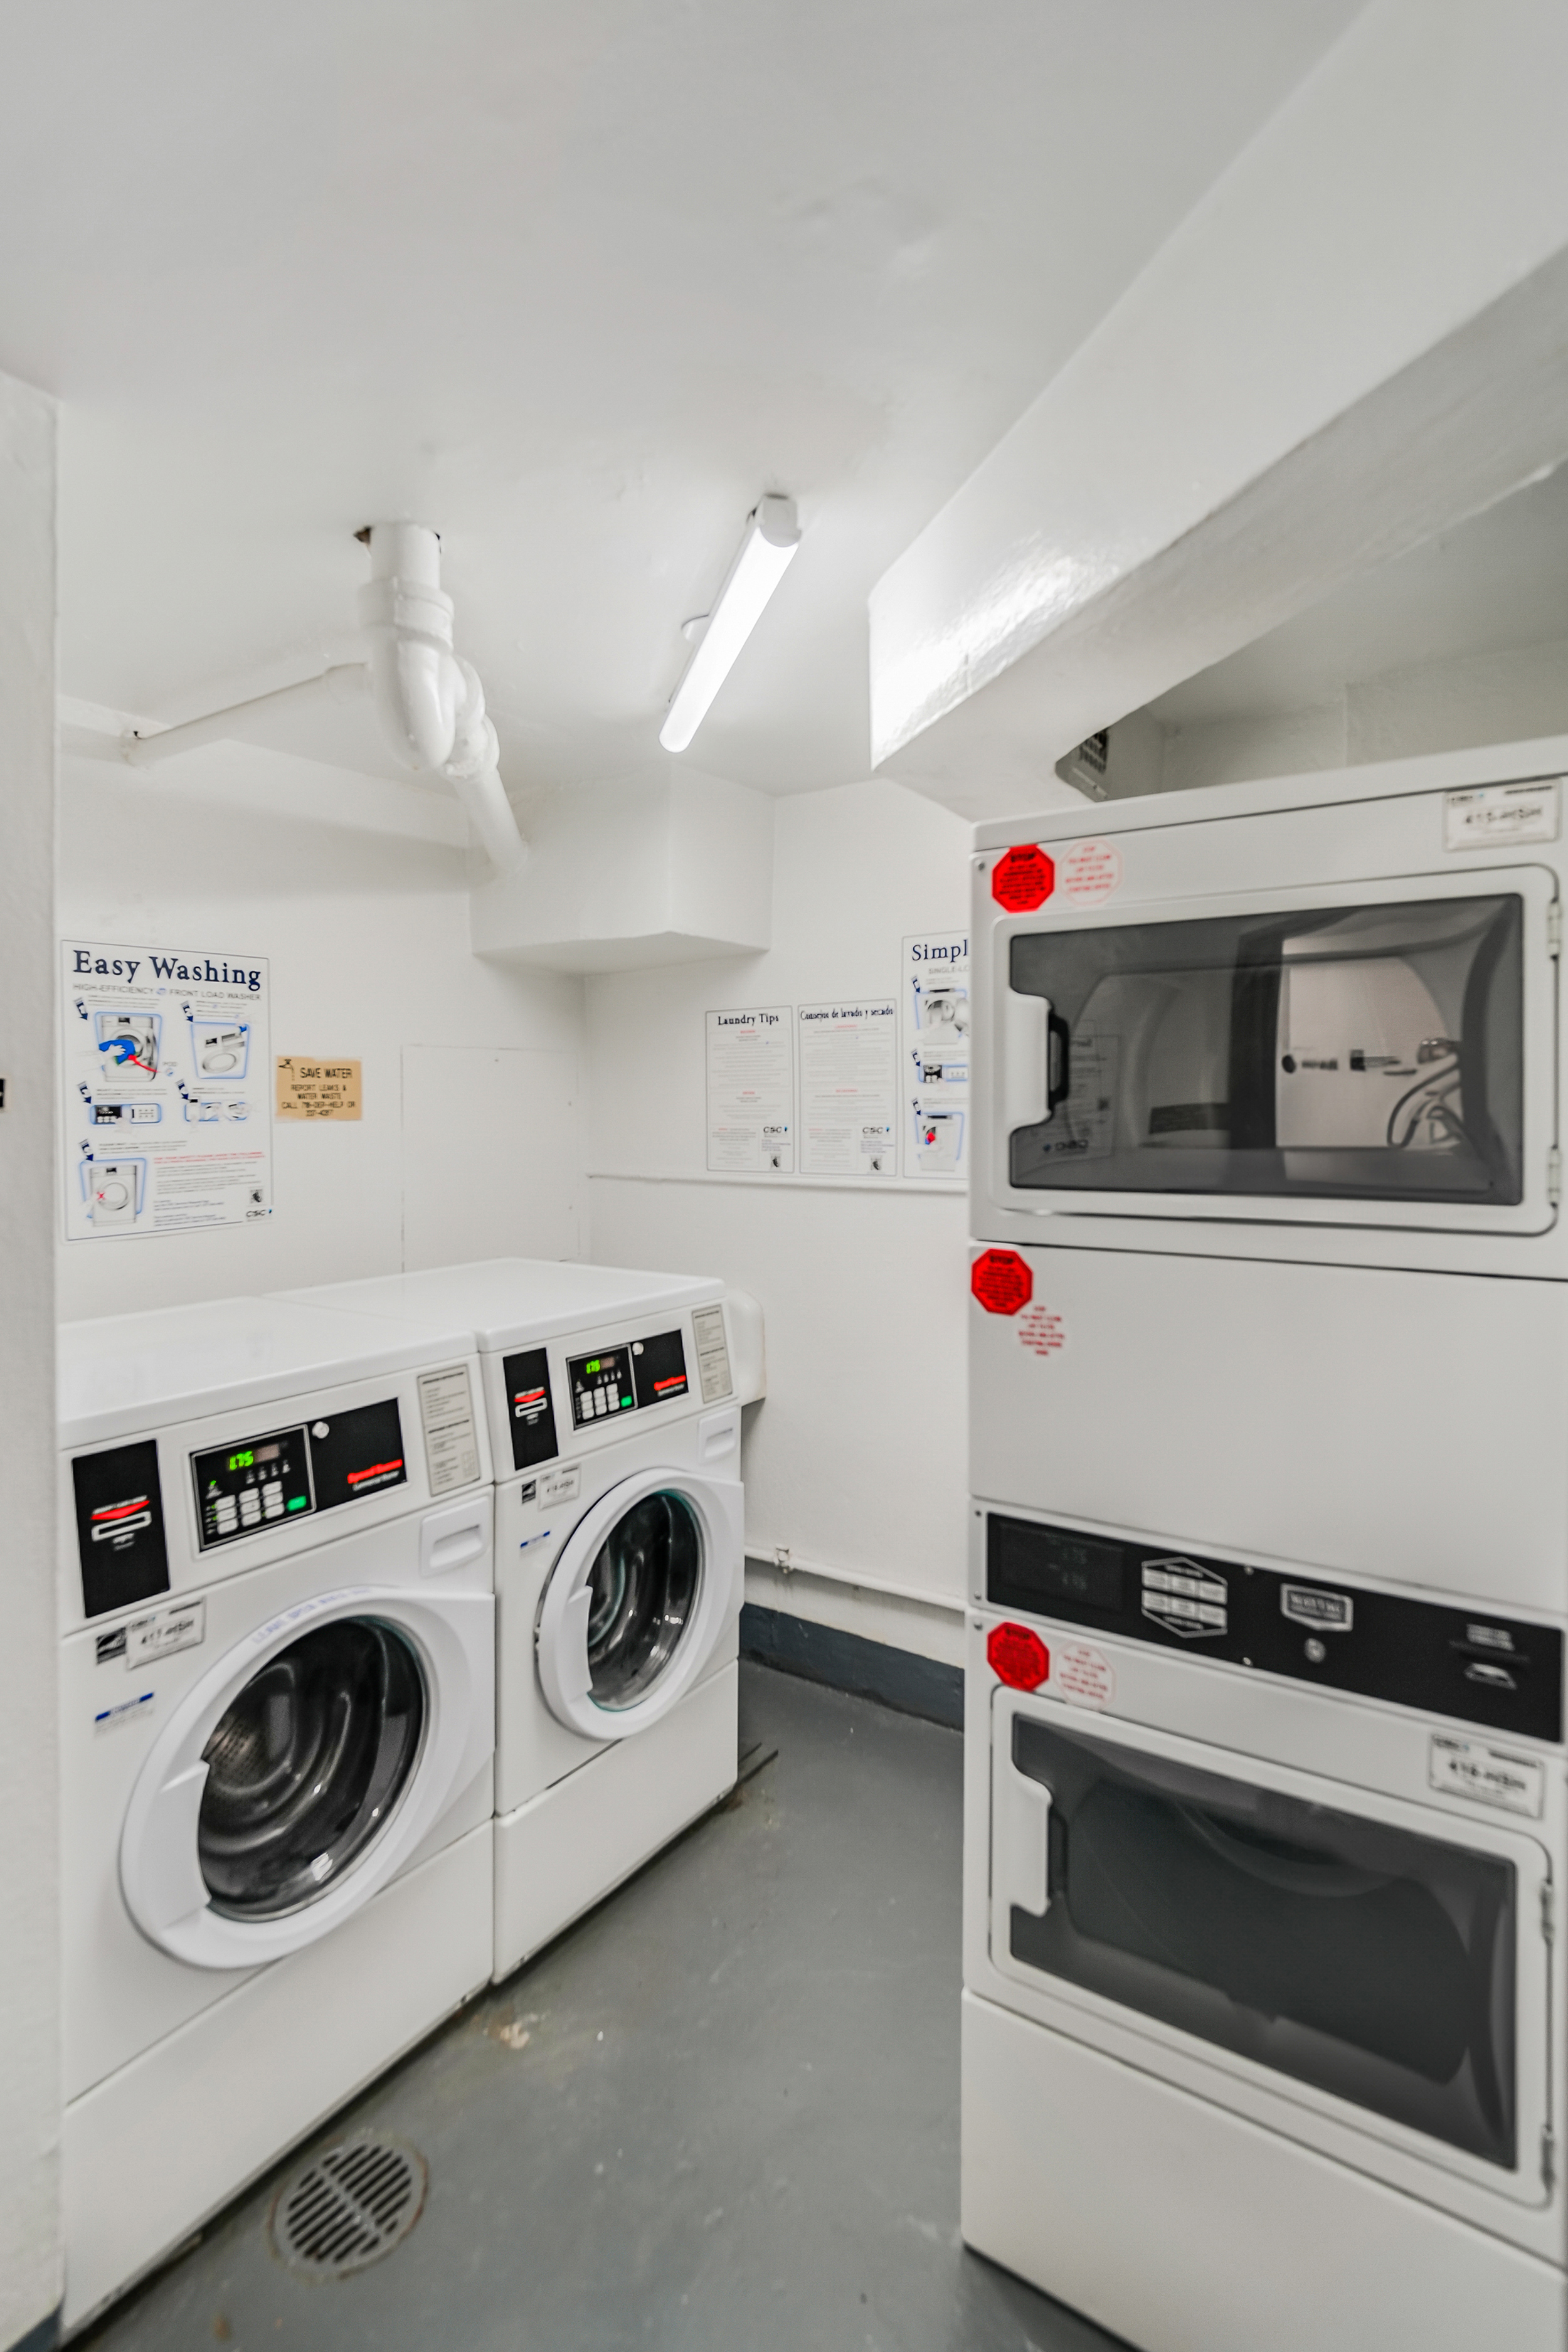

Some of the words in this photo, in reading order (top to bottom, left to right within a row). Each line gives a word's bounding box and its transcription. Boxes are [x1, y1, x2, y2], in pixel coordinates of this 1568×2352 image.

[912, 939, 968, 963] Simpl
[73, 950, 141, 983] Easy
[149, 956, 261, 992] Washing
[169, 988, 198, 997] FRONT
[201, 991, 225, 999] LOAD
[227, 993, 262, 1001] WASHER
[718, 1014, 756, 1026] Laundry
[759, 1013, 779, 1025] Tips
[832, 1008, 839, 1019] de
[300, 1067, 322, 1079] SAVE
[324, 1068, 352, 1079] WATER
